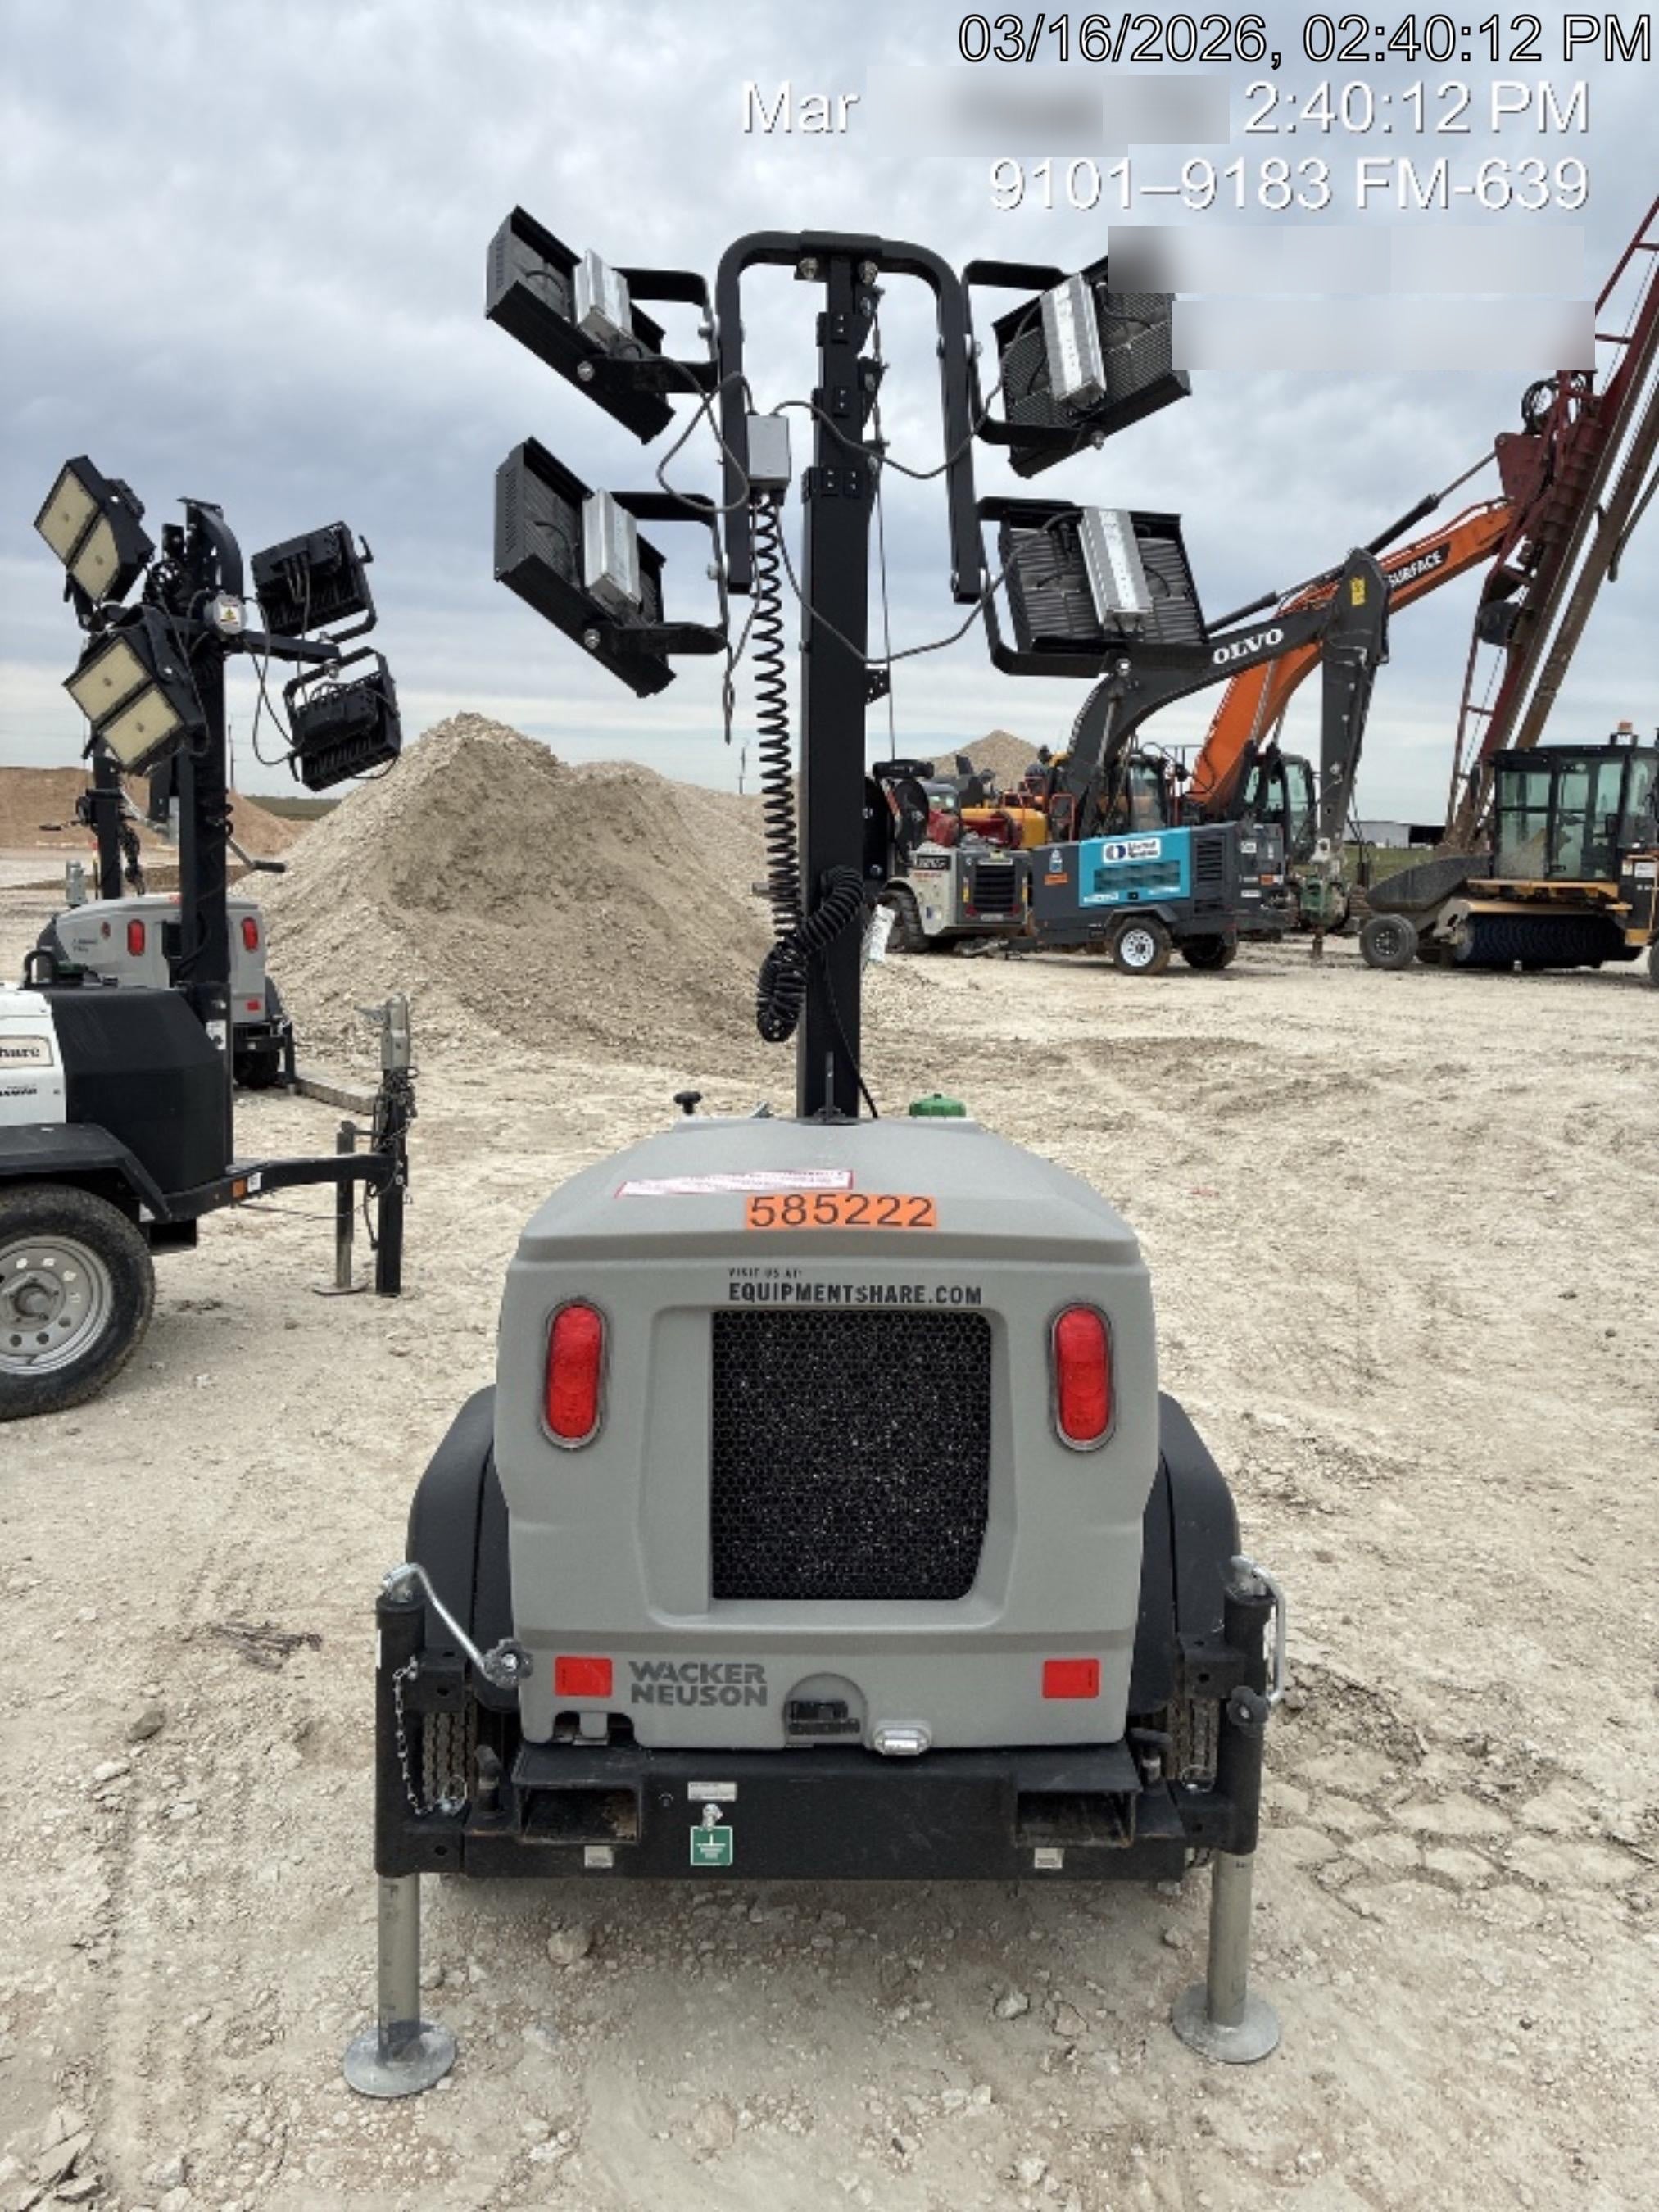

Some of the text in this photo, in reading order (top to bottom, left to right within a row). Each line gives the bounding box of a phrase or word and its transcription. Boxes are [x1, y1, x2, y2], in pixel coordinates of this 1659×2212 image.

[1213, 628, 1285, 665] OLVO
[750, 1194, 934, 1227] 585222
[728, 1267, 760, 1278] VISIT
[764, 1268, 781, 1279] US
[728, 1282, 982, 1305] EQUIPMENTSHARE.COM
[628, 1661, 768, 1684] WACKER
[630, 1684, 768, 1707] NEUSON
